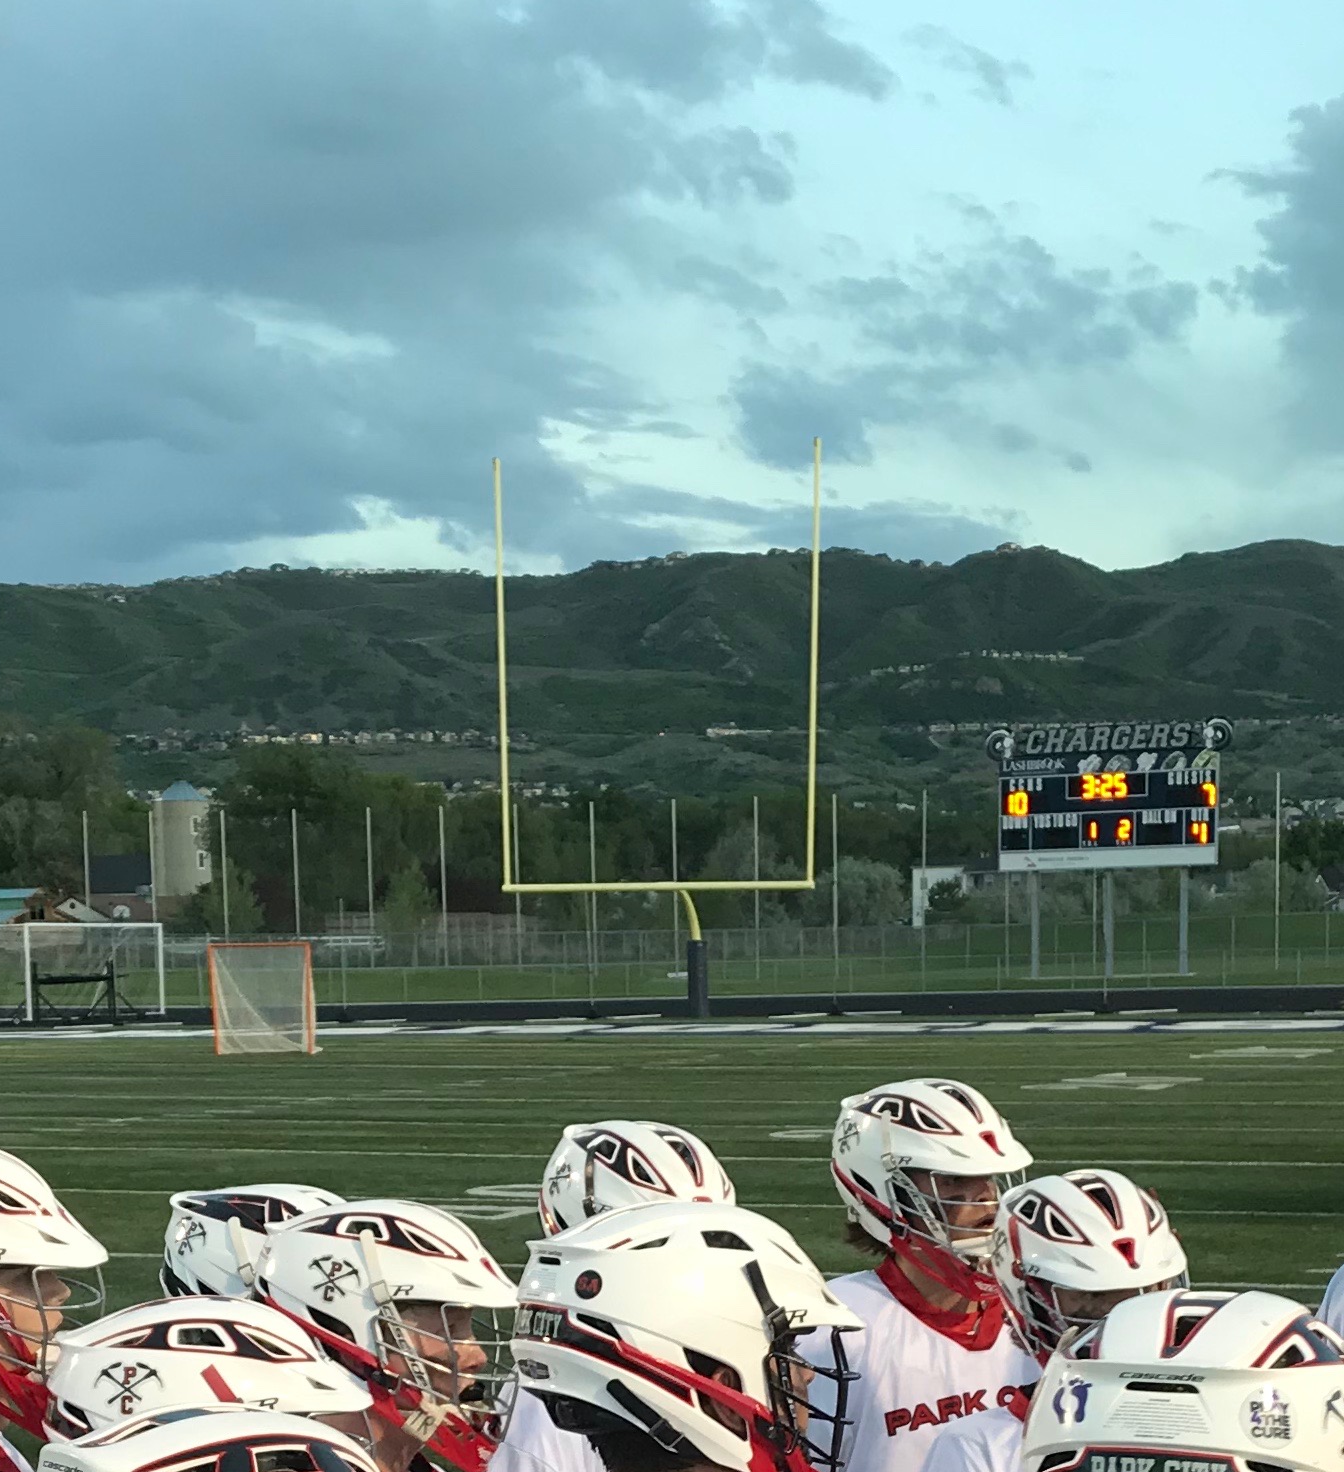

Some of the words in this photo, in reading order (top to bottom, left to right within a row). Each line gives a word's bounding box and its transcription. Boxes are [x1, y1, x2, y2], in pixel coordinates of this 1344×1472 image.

[1026, 723, 1191, 754] CHARGERS
[1082, 773, 1128, 799] 3:25
[1202, 782, 1216, 806] 7
[1008, 792, 1028, 816] 10
[1117, 818, 1131, 839] 2
[1118, 1371, 1206, 1382] cascade
[884, 1388, 988, 1437] PARK
[1251, 1426, 1291, 1440] CURE
